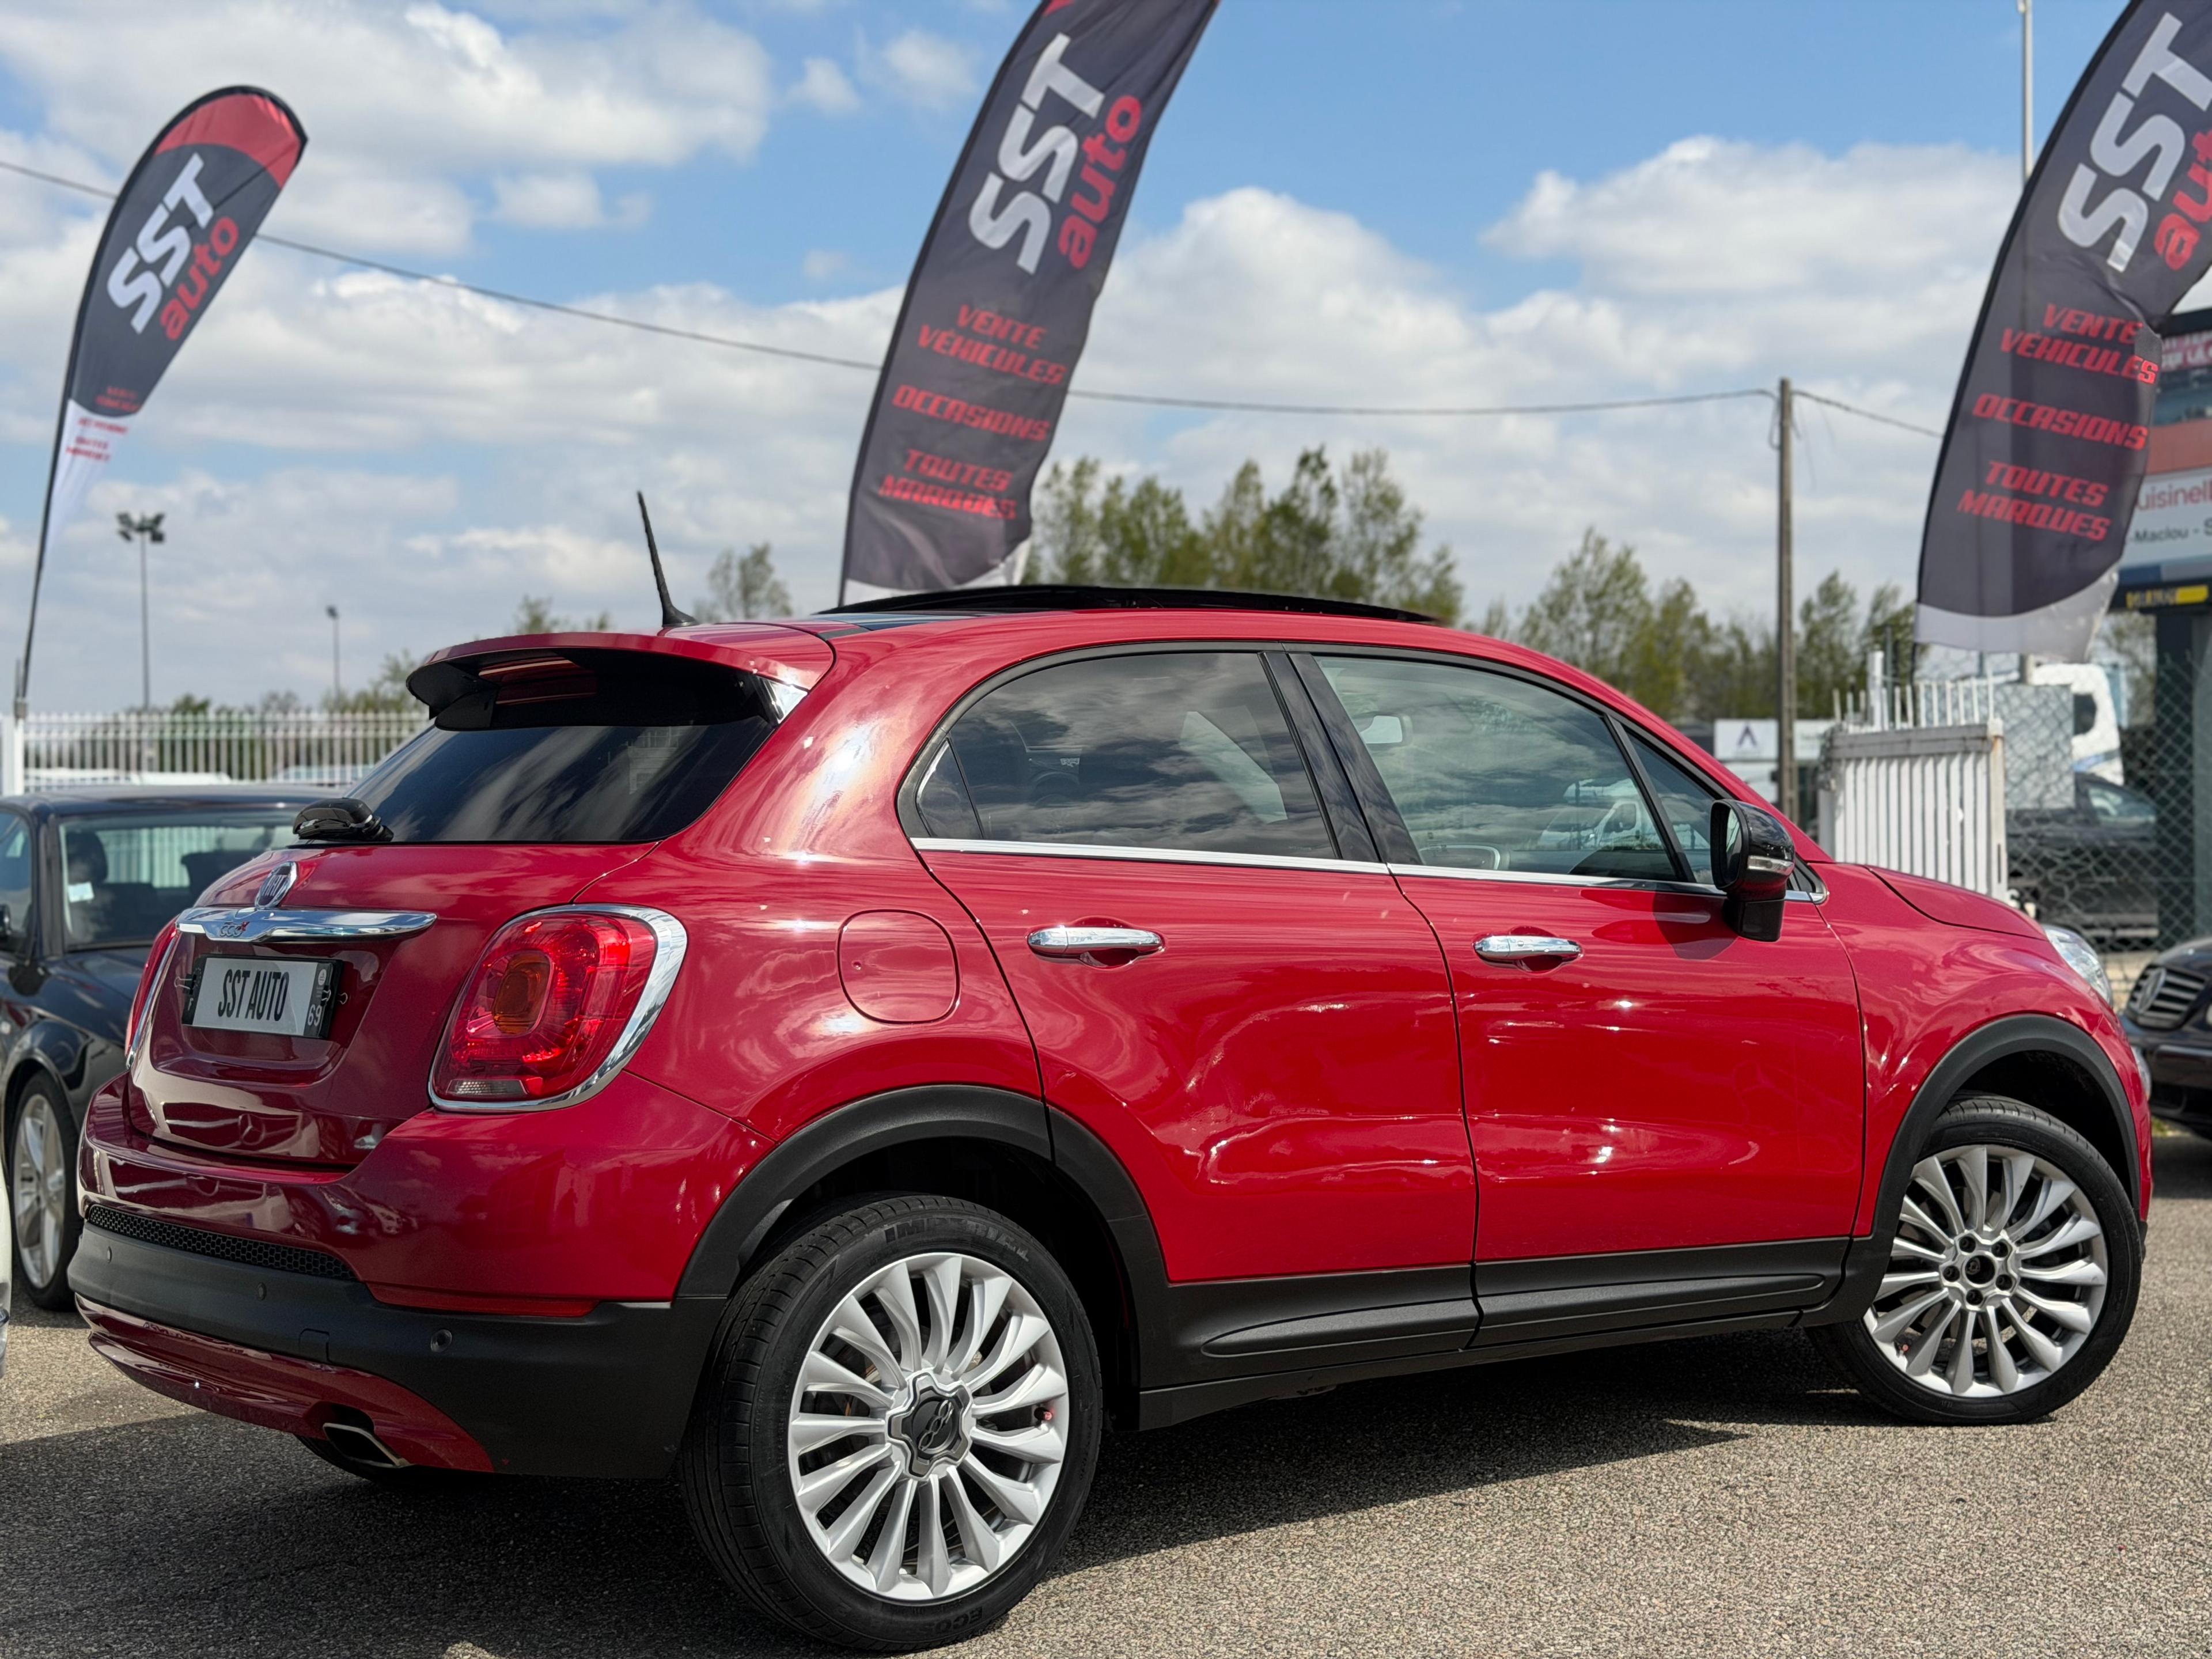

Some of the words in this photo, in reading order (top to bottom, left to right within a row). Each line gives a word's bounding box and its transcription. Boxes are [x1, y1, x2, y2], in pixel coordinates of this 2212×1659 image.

[969, 33, 1105, 275] SST
[2058, 12, 2212, 272] SST
[1058, 95, 1142, 269] auto
[107, 153, 214, 334] SST
[160, 217, 238, 341] auto
[956, 304, 1047, 350] VENTE
[2043, 304, 2143, 344] VENTE
[918, 324, 1067, 385] VÉHICULES
[2000, 328, 2159, 385] VÉHICULES
[892, 384, 1051, 441] OCCASIONS
[1972, 393, 2149, 451] OCCASIONS
[879, 474, 1016, 520] MARQUES
[904, 449, 1013, 492] TOUTES
[1985, 461, 2109, 507] TOUTES
[1957, 490, 2111, 541] MARQUES
[218, 969, 251, 1018] SST
[244, 971, 290, 1021] AUTO
[307, 1004, 323, 1027] 69
